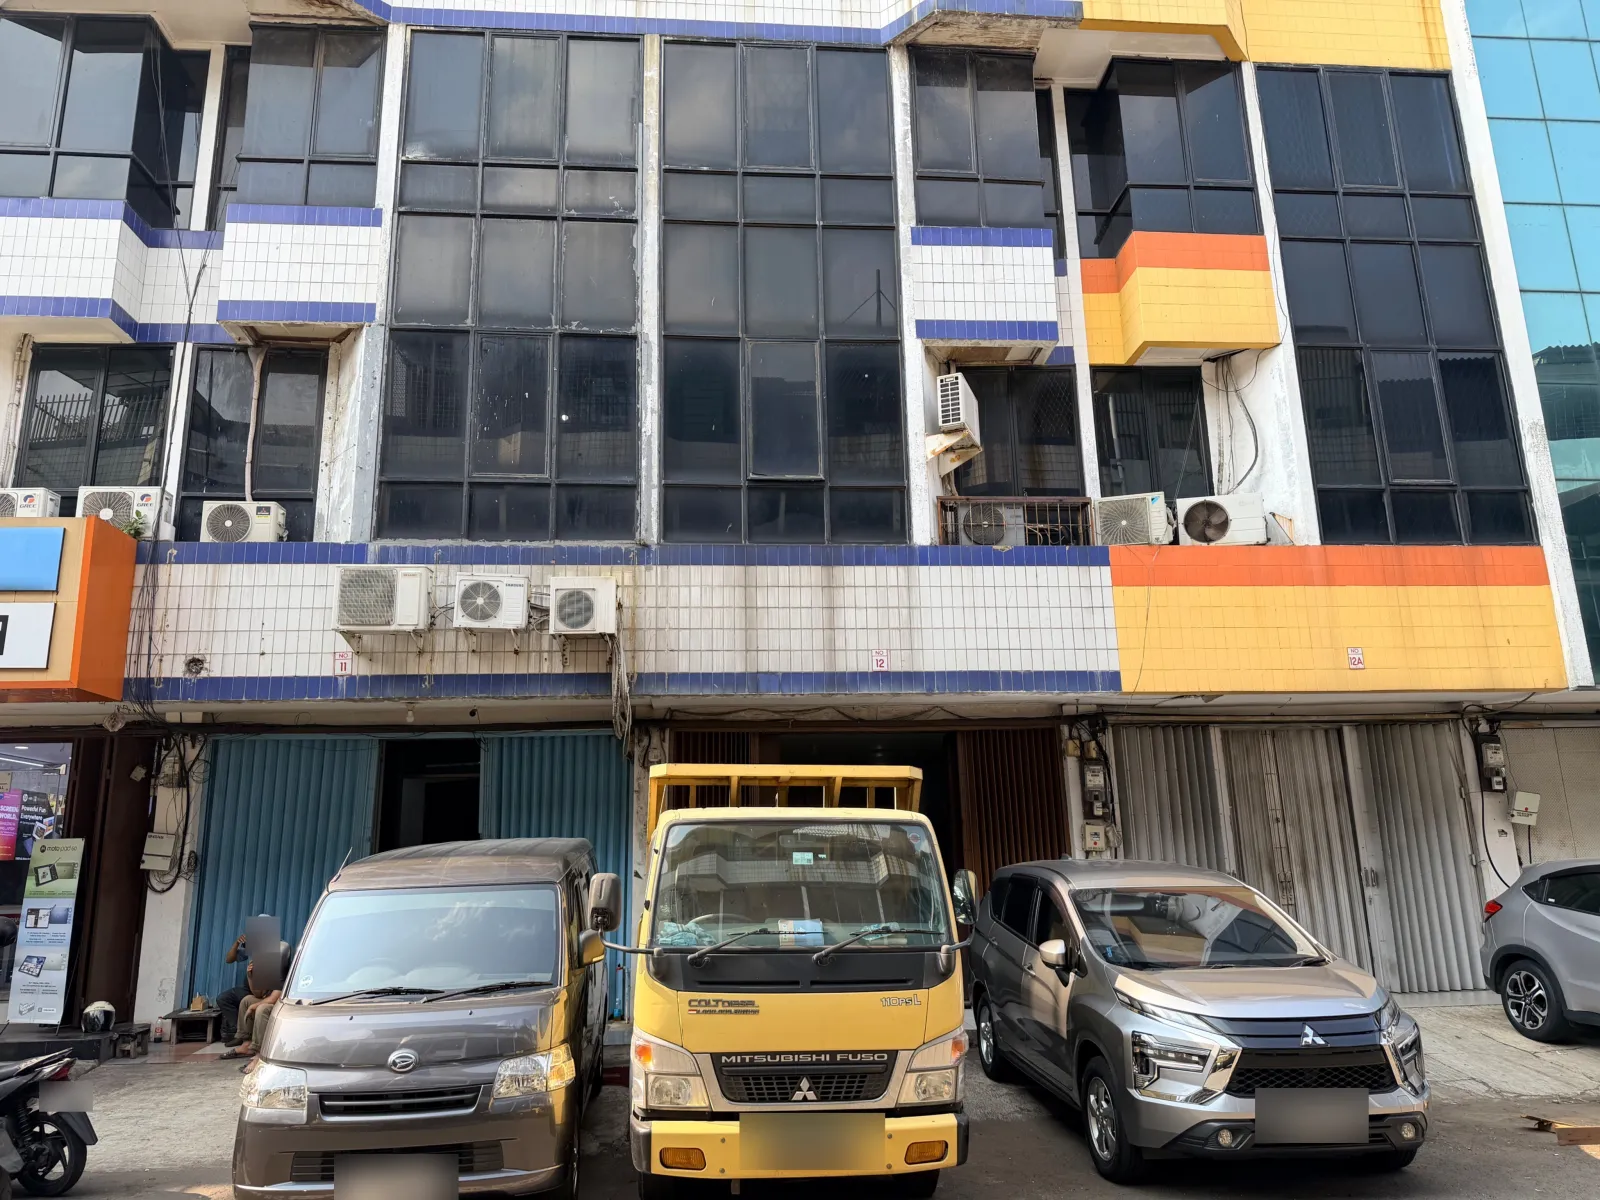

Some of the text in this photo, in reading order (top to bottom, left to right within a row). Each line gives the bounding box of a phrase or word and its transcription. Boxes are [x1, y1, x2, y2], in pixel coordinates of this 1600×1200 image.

[875, 658, 885, 668] 12
[1349, 656, 1364, 666] 12A
[340, 661, 347, 672] 11
[721, 1053, 888, 1063] MITSUBISHI FUSO
